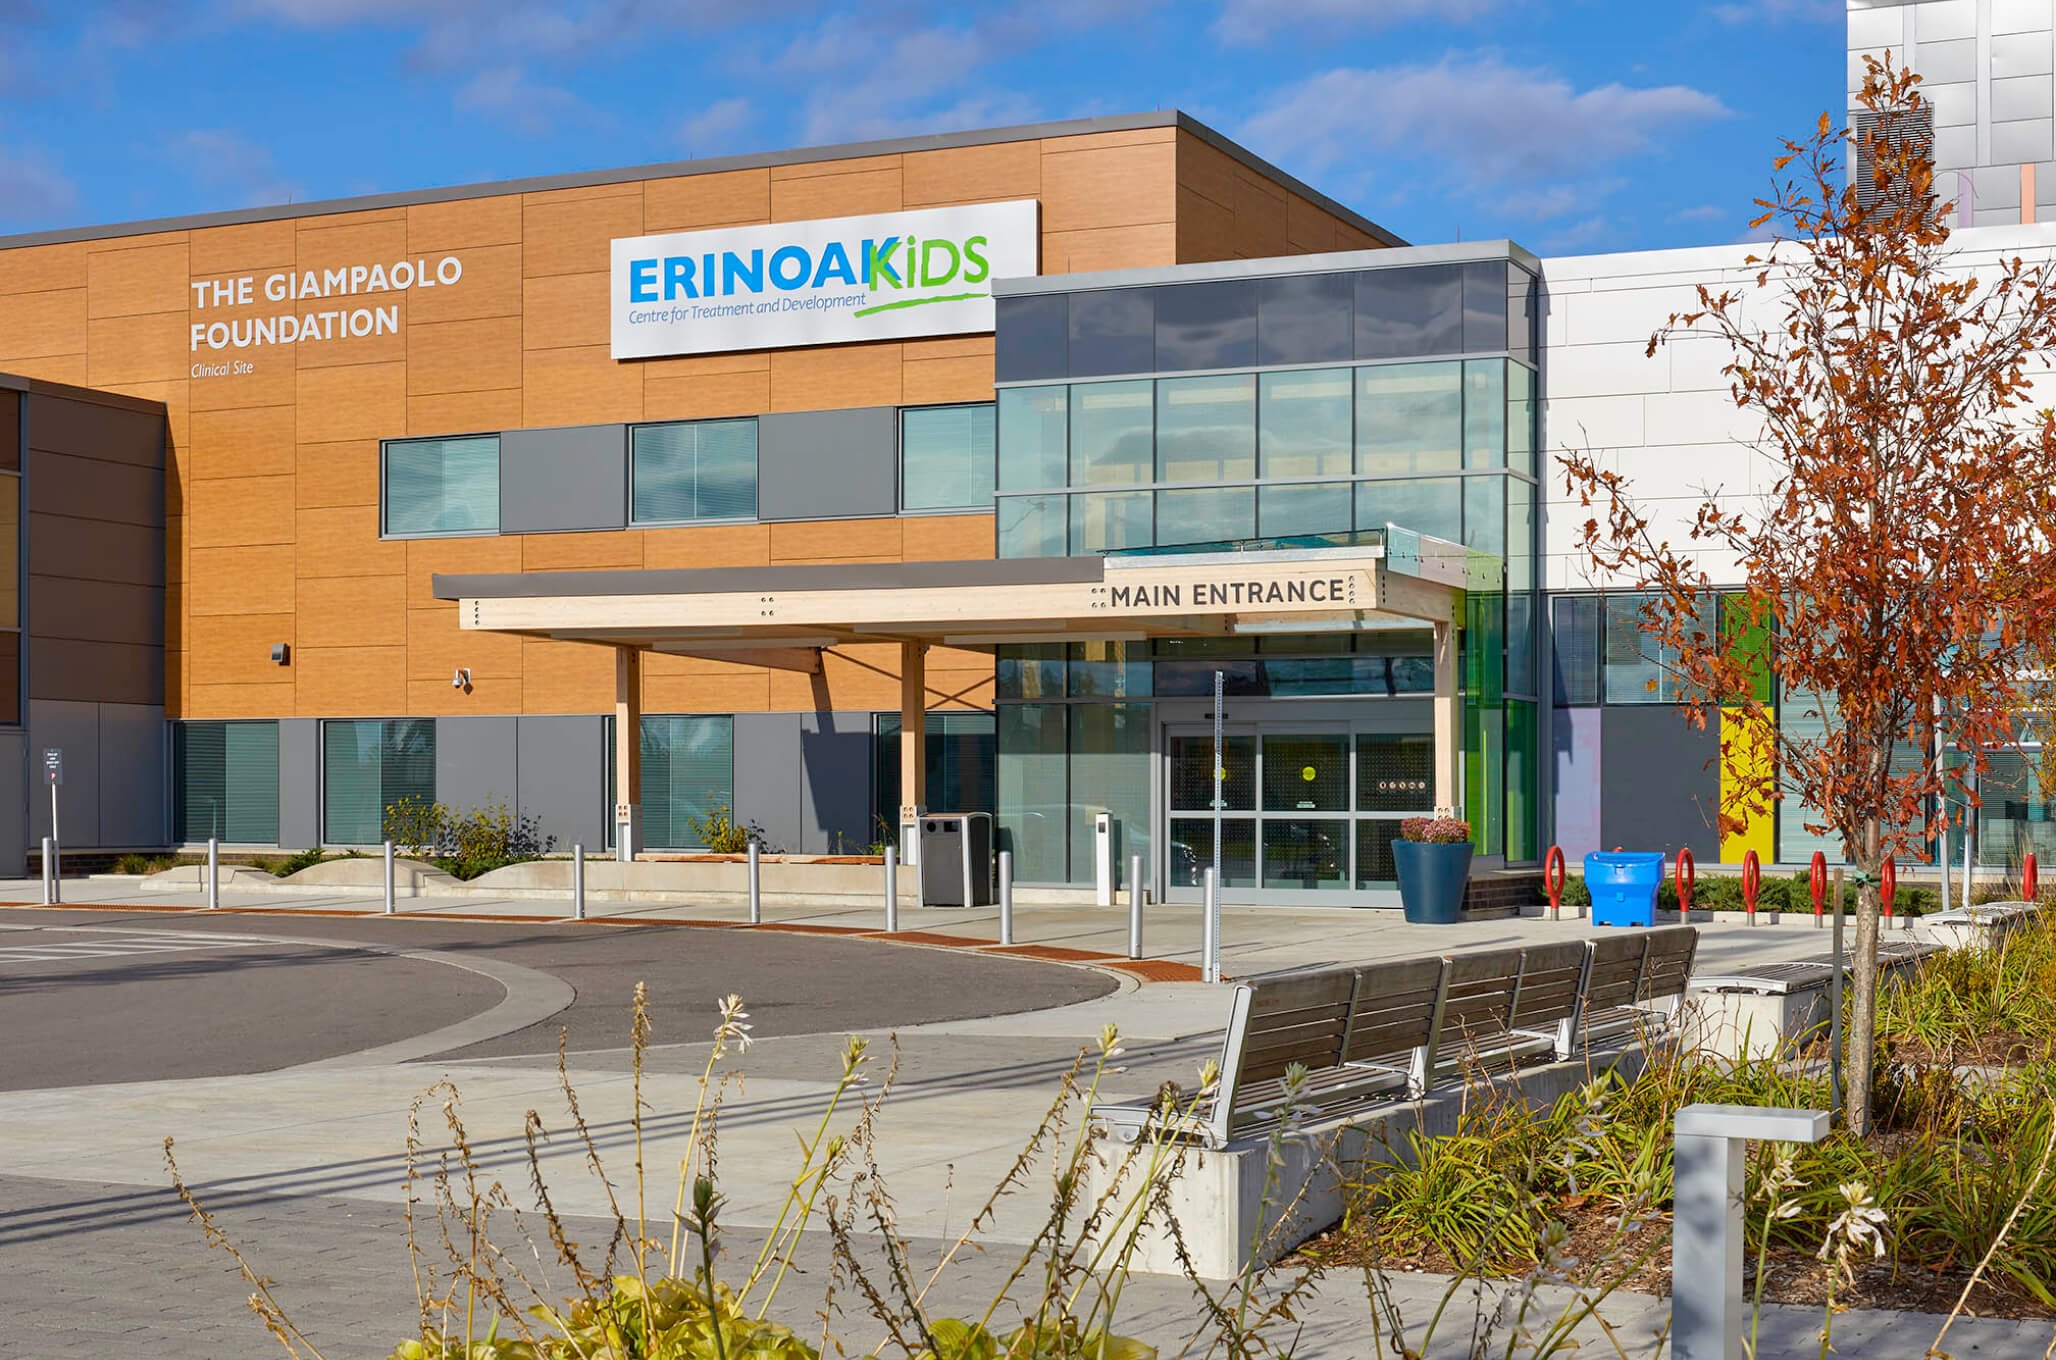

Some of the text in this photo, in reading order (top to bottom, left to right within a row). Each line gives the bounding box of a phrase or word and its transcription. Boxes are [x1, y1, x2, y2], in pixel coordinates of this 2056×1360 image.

[191, 256, 463, 309] THE GIAMPAOLO
[628, 292, 867, 325] Centre for Treatment and Development
[191, 305, 399, 352] FOUNDATION
[191, 359, 254, 378] Clinical Site
[1111, 579, 1345, 608] MAIN ENTRANCE
